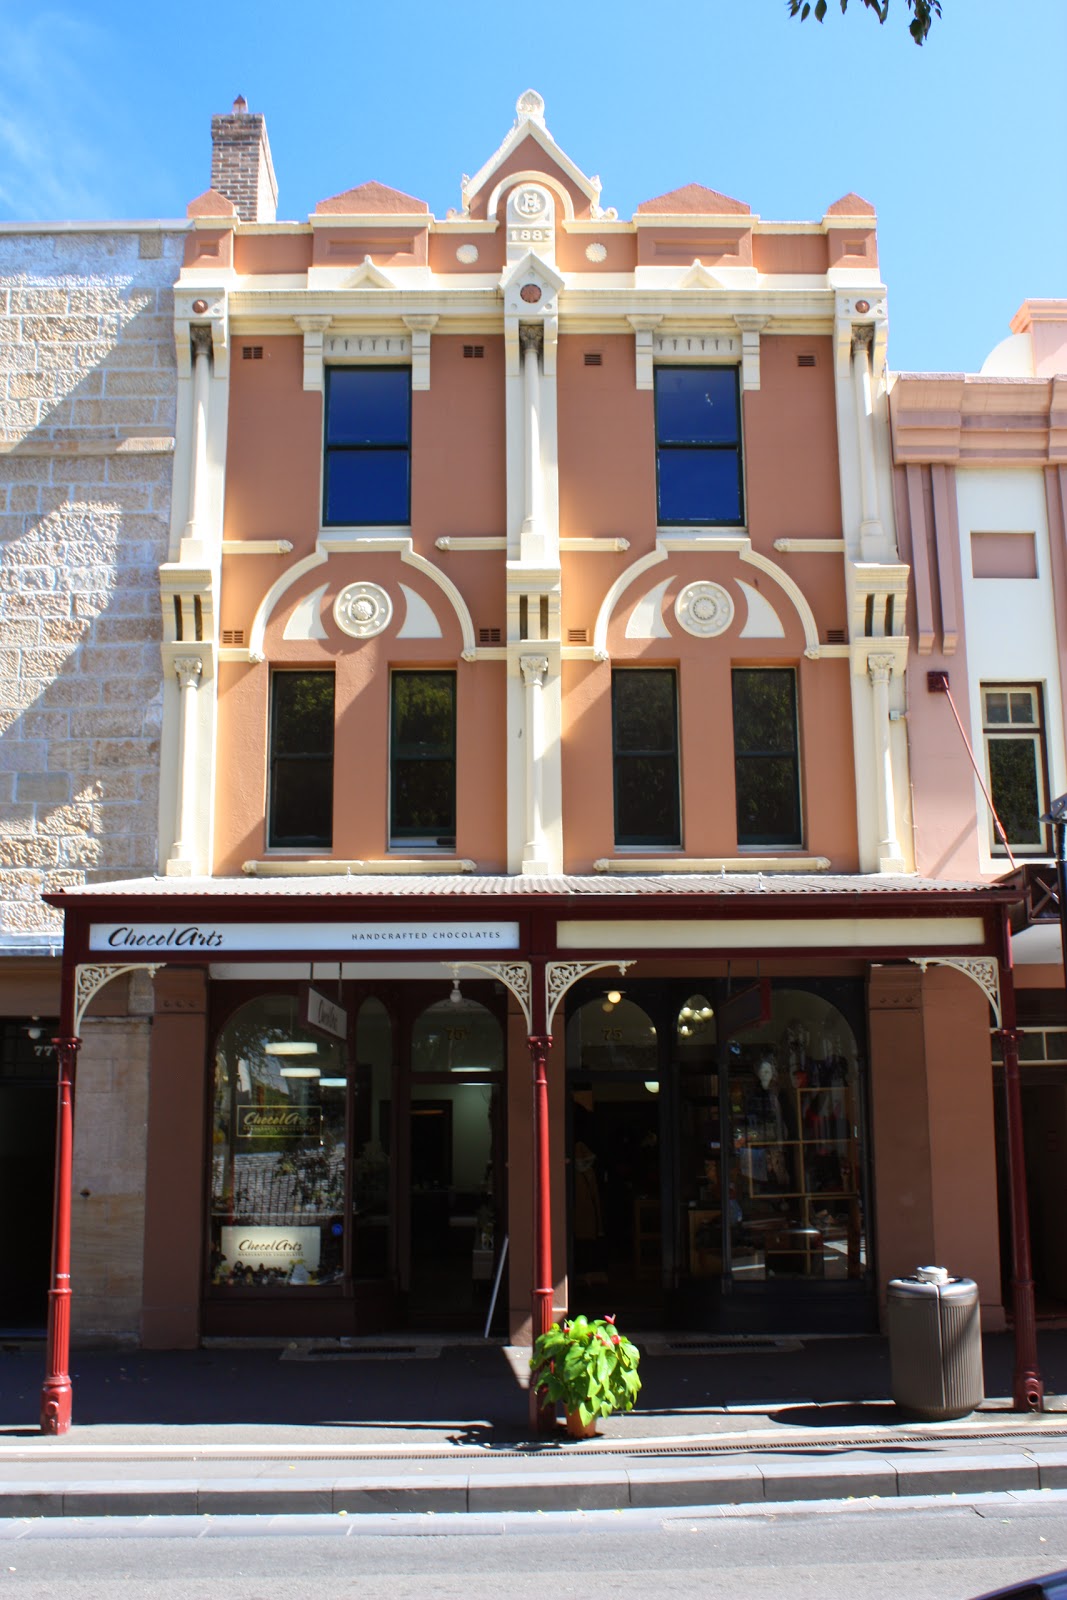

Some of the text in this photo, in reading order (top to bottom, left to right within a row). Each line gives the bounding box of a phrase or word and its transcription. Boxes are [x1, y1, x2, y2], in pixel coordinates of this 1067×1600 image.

[108, 927, 223, 947] ChocolArts
[351, 931, 501, 941] HANDCRAFTED CHOCOLATES
[602, 1026, 624, 1041] 75
[34, 1045, 53, 1057] 77
[238, 1239, 303, 1251] ChocolArts
